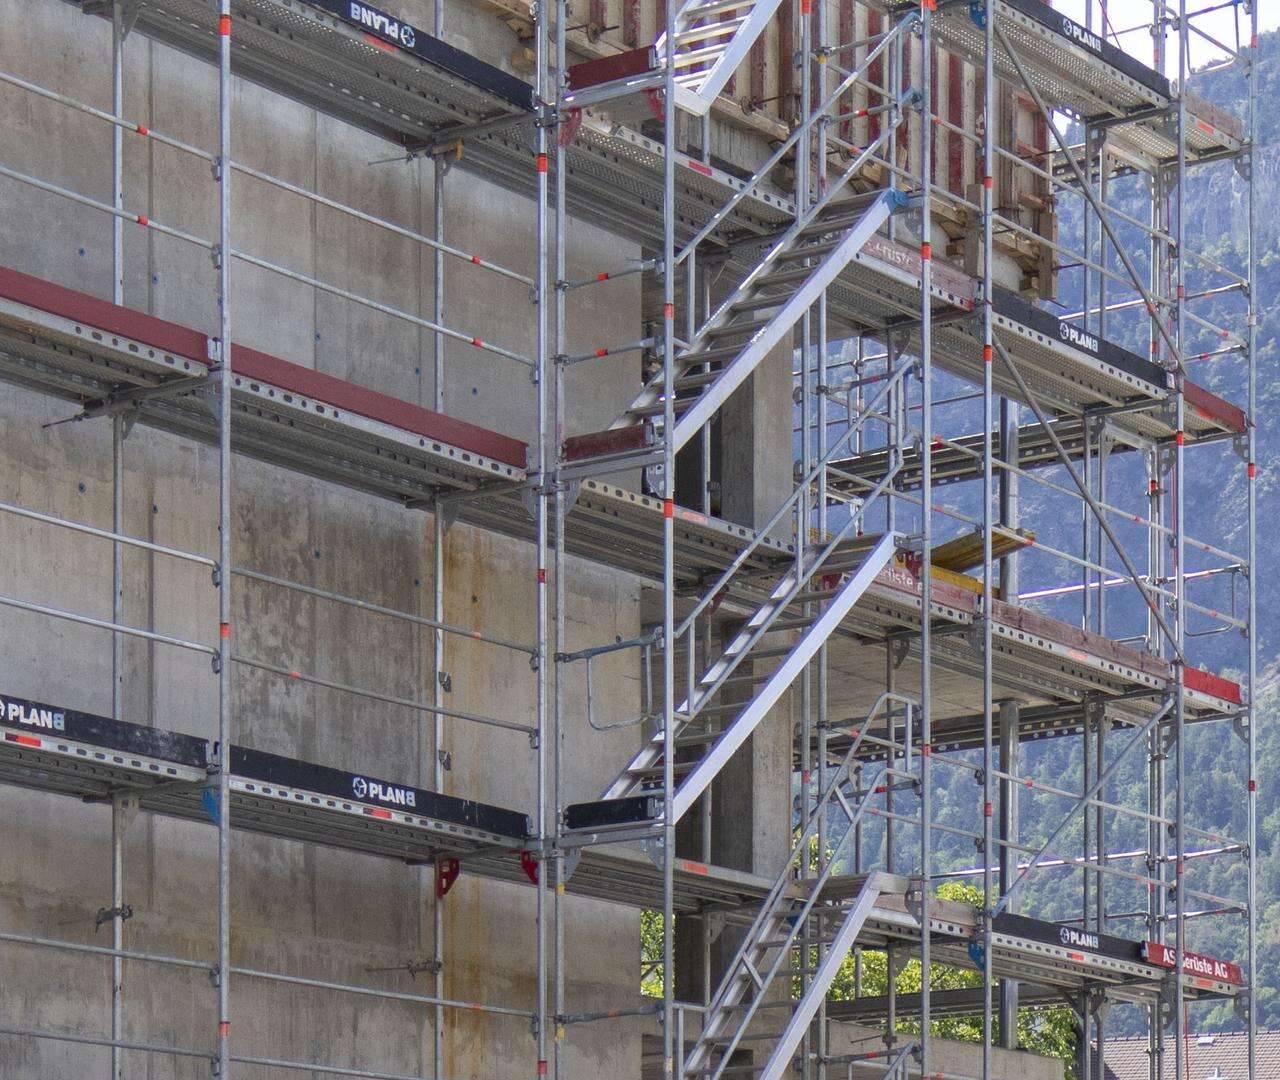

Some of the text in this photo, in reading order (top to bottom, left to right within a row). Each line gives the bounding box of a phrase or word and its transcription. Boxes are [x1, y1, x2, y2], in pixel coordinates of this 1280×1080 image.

[8, 701, 66, 731] PLANB
[369, 782, 416, 807] PLANB
[1163, 949, 1176, 964] AS
[1214, 962, 1228, 978] AG
